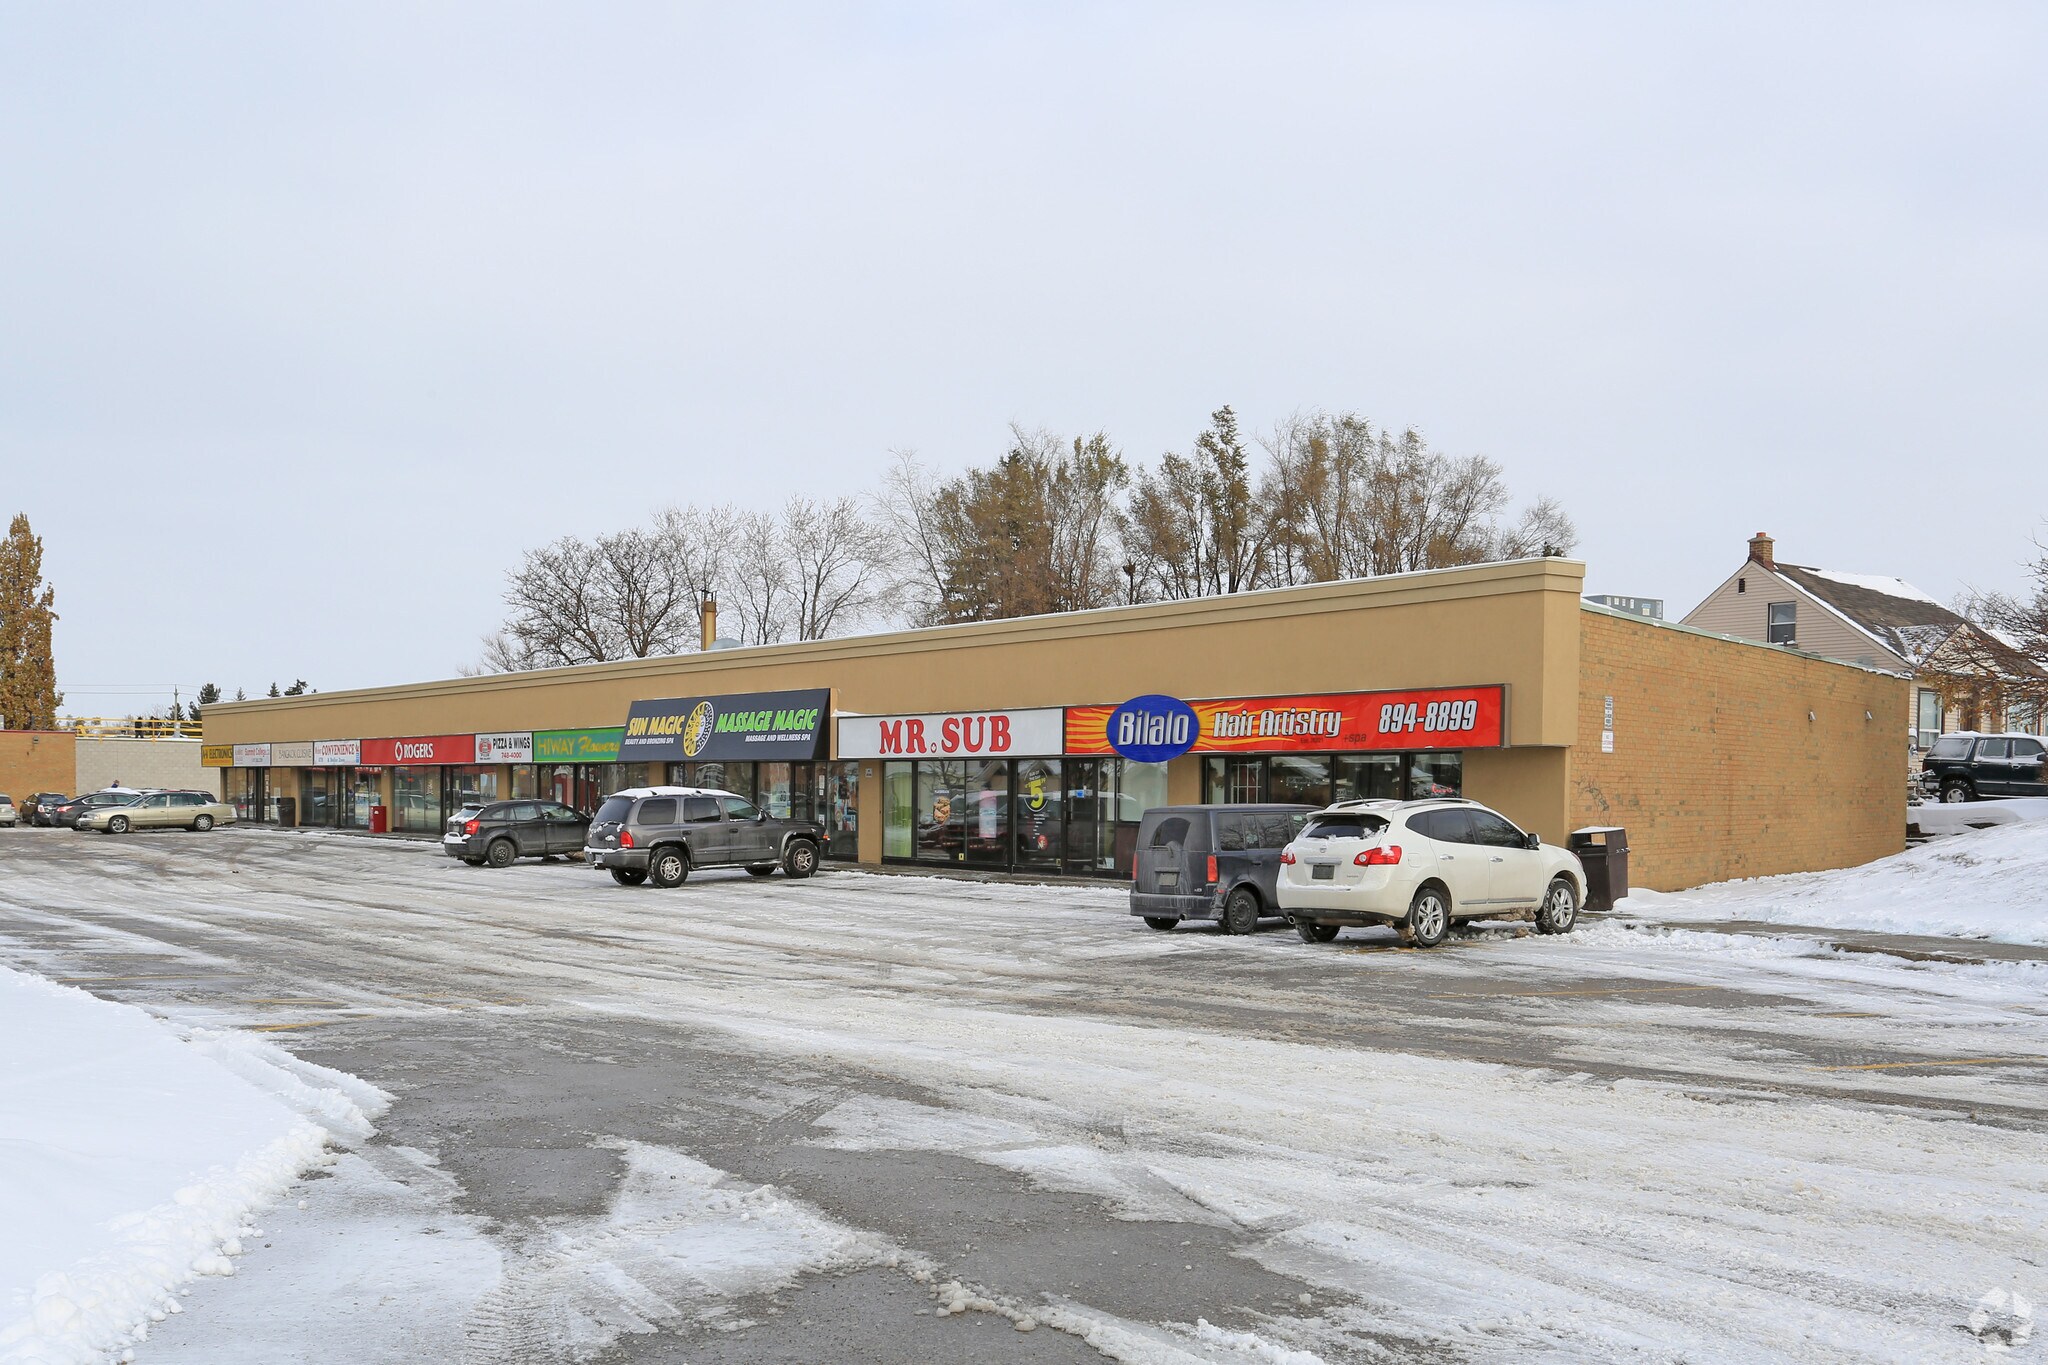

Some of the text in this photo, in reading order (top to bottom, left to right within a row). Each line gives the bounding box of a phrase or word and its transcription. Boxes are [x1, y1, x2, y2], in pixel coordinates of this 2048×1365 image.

[626, 715, 686, 736] SUN MAGIC
[715, 708, 819, 734] MASSAGE MAGIC
[1213, 707, 1342, 738] Hair Artistry
[1378, 699, 1478, 734] 894-8899
[1117, 708, 1189, 746] Bilalo
[493, 737, 507, 749] PIZZA
[513, 737, 530, 749] WINGS
[537, 736, 620, 756] HIWAY Flowers
[639, 737, 647, 745] AND
[745, 734, 767, 743] MASSAGE
[767, 734, 777, 742] AND
[777, 734, 801, 742] WELLNESS
[322, 743, 355, 756] CONVENIENCE
[404, 743, 434, 758] ROGERS
